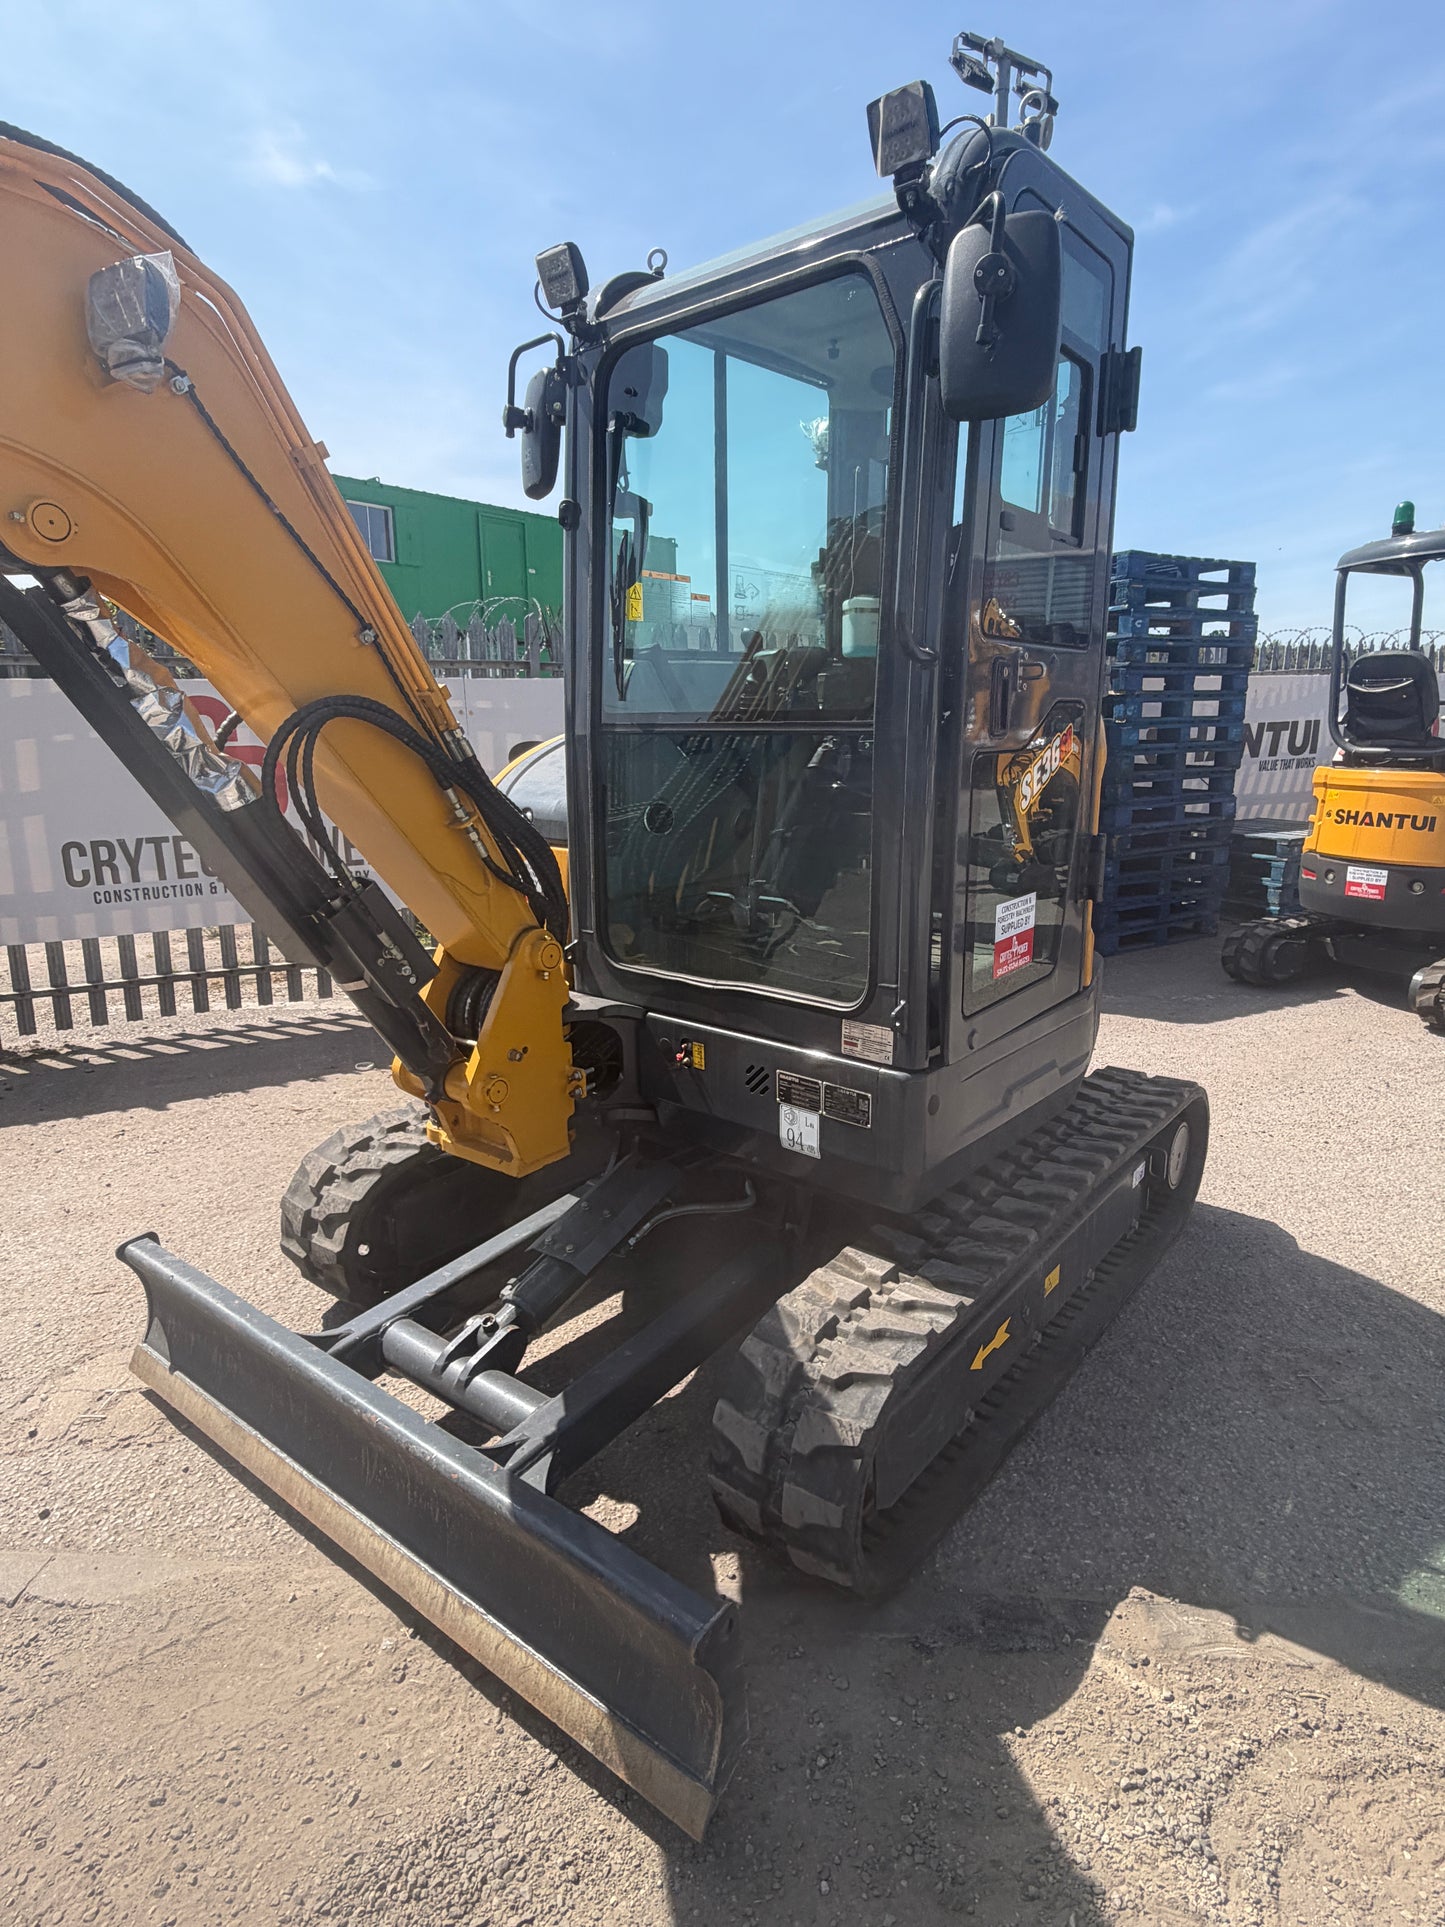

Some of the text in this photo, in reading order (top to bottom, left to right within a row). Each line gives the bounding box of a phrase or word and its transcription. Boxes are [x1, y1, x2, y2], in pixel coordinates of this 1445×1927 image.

[1240, 720, 1321, 758] NTUI
[1259, 757, 1316, 772] VALUE THAT WORKS
[1334, 808, 1437, 832] SHANTUI
[61, 835, 218, 888] CRYTE
[93, 882, 203, 905] CONSTRUCTION
[209, 881, 218, 895] &
[786, 1127, 805, 1152] 94
